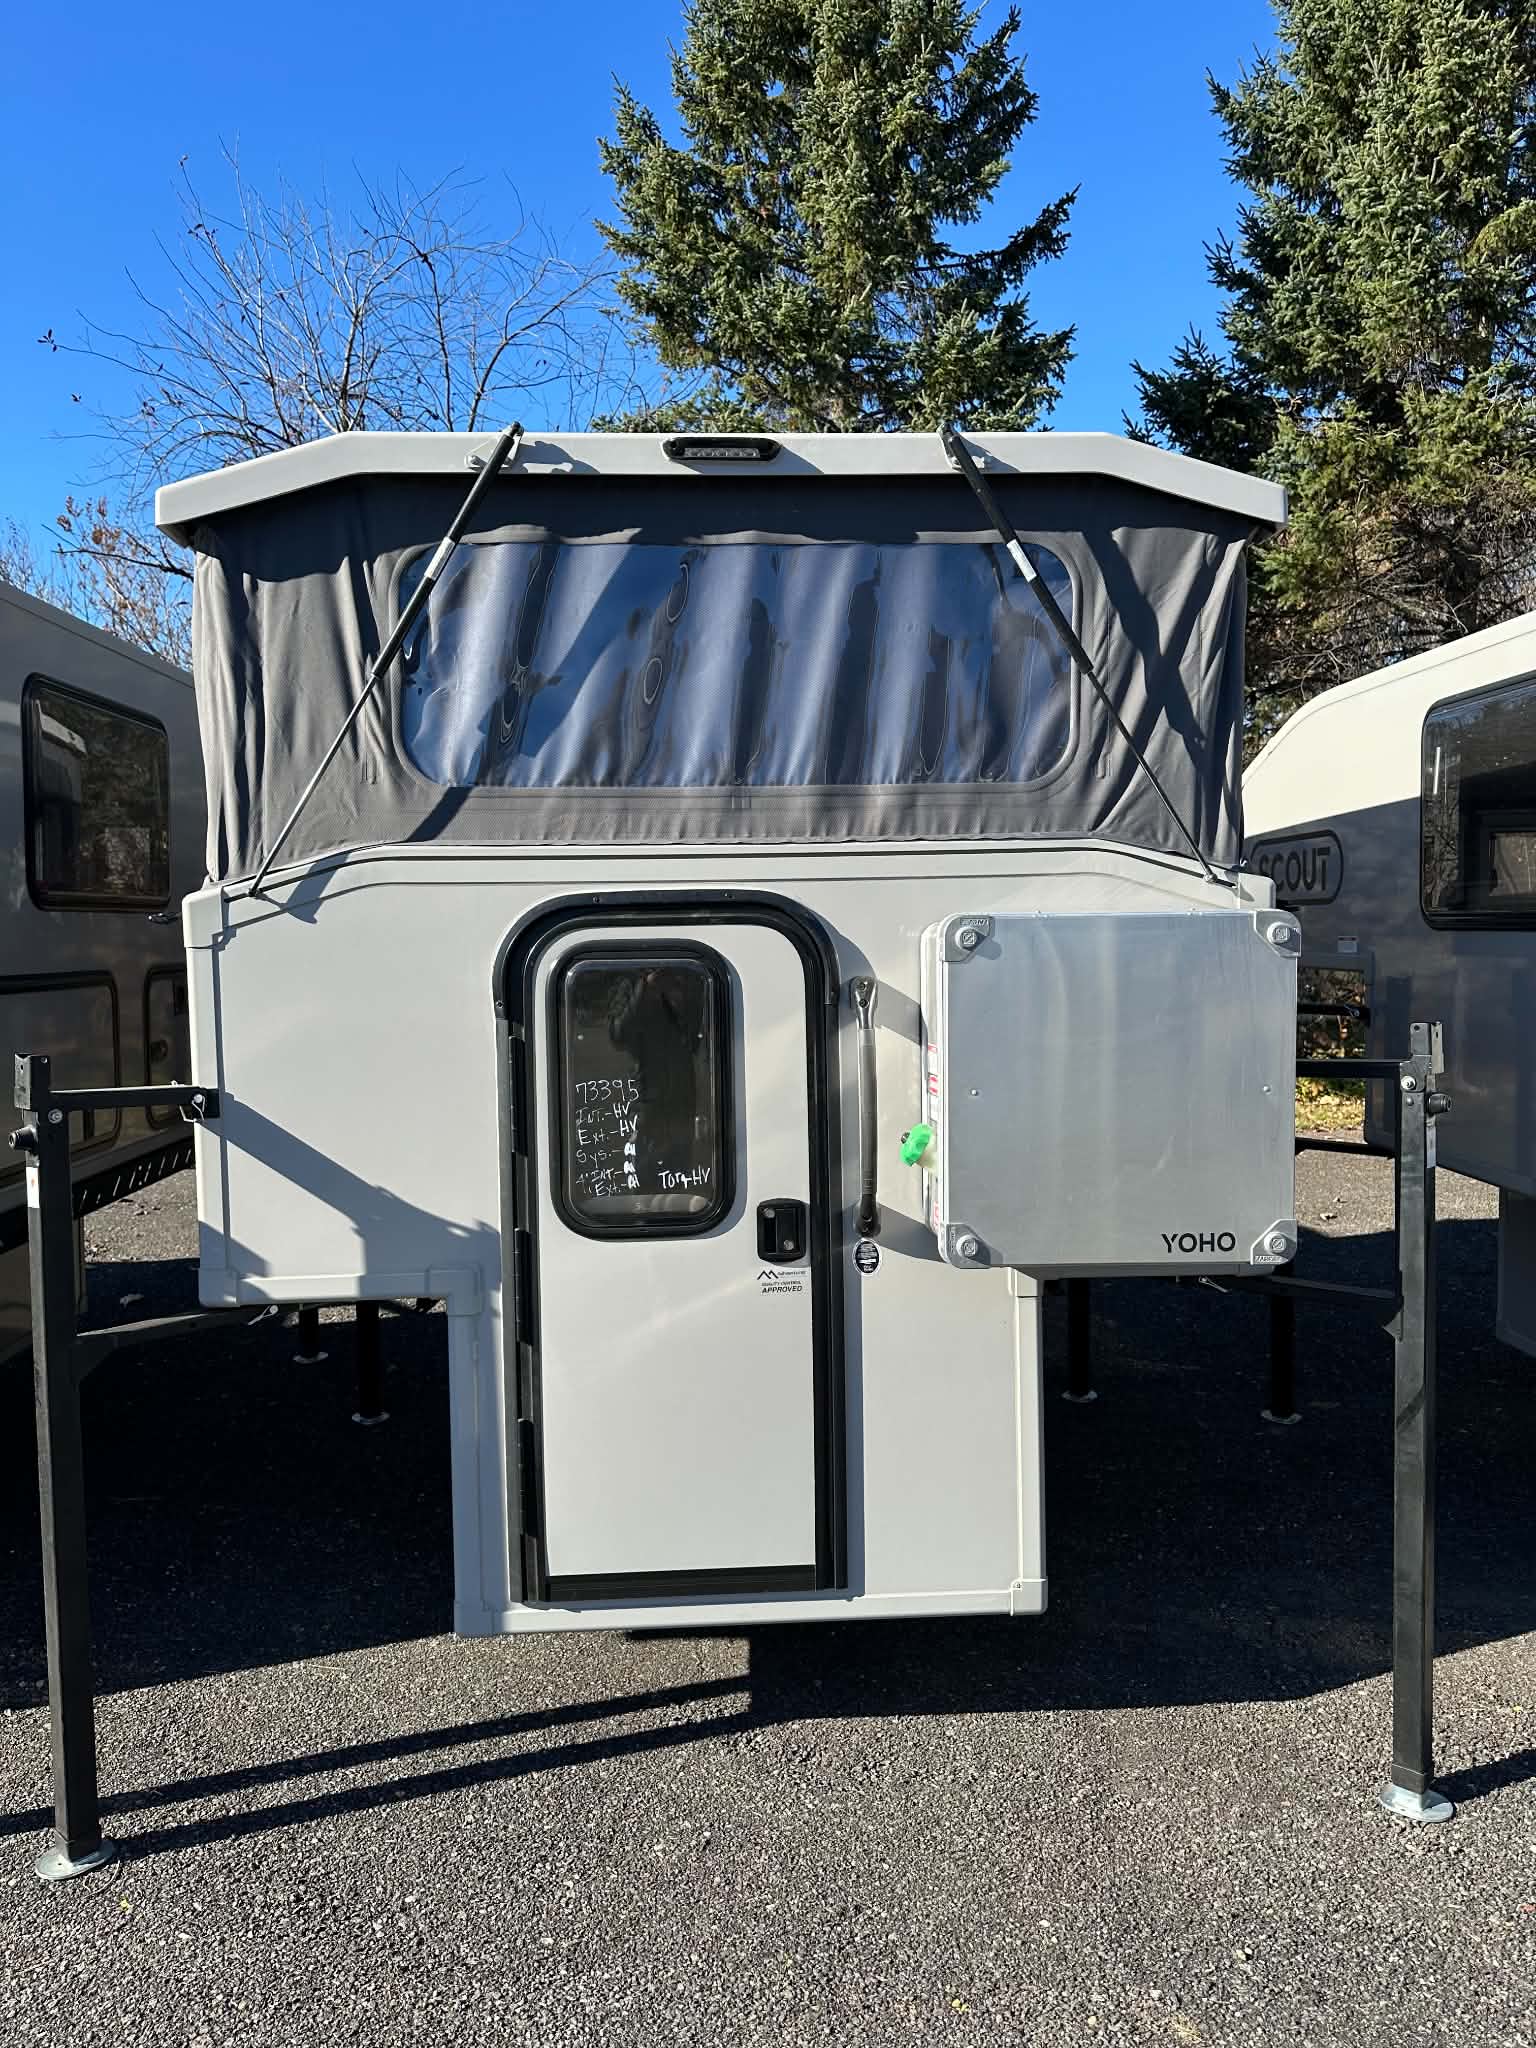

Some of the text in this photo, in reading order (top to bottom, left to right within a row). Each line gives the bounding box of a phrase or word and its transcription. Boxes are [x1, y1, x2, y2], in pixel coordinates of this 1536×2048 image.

[575, 1079, 639, 1103] 73395
[1161, 1231, 1237, 1253] YOHO
[762, 1285, 803, 1293] APPROVED
